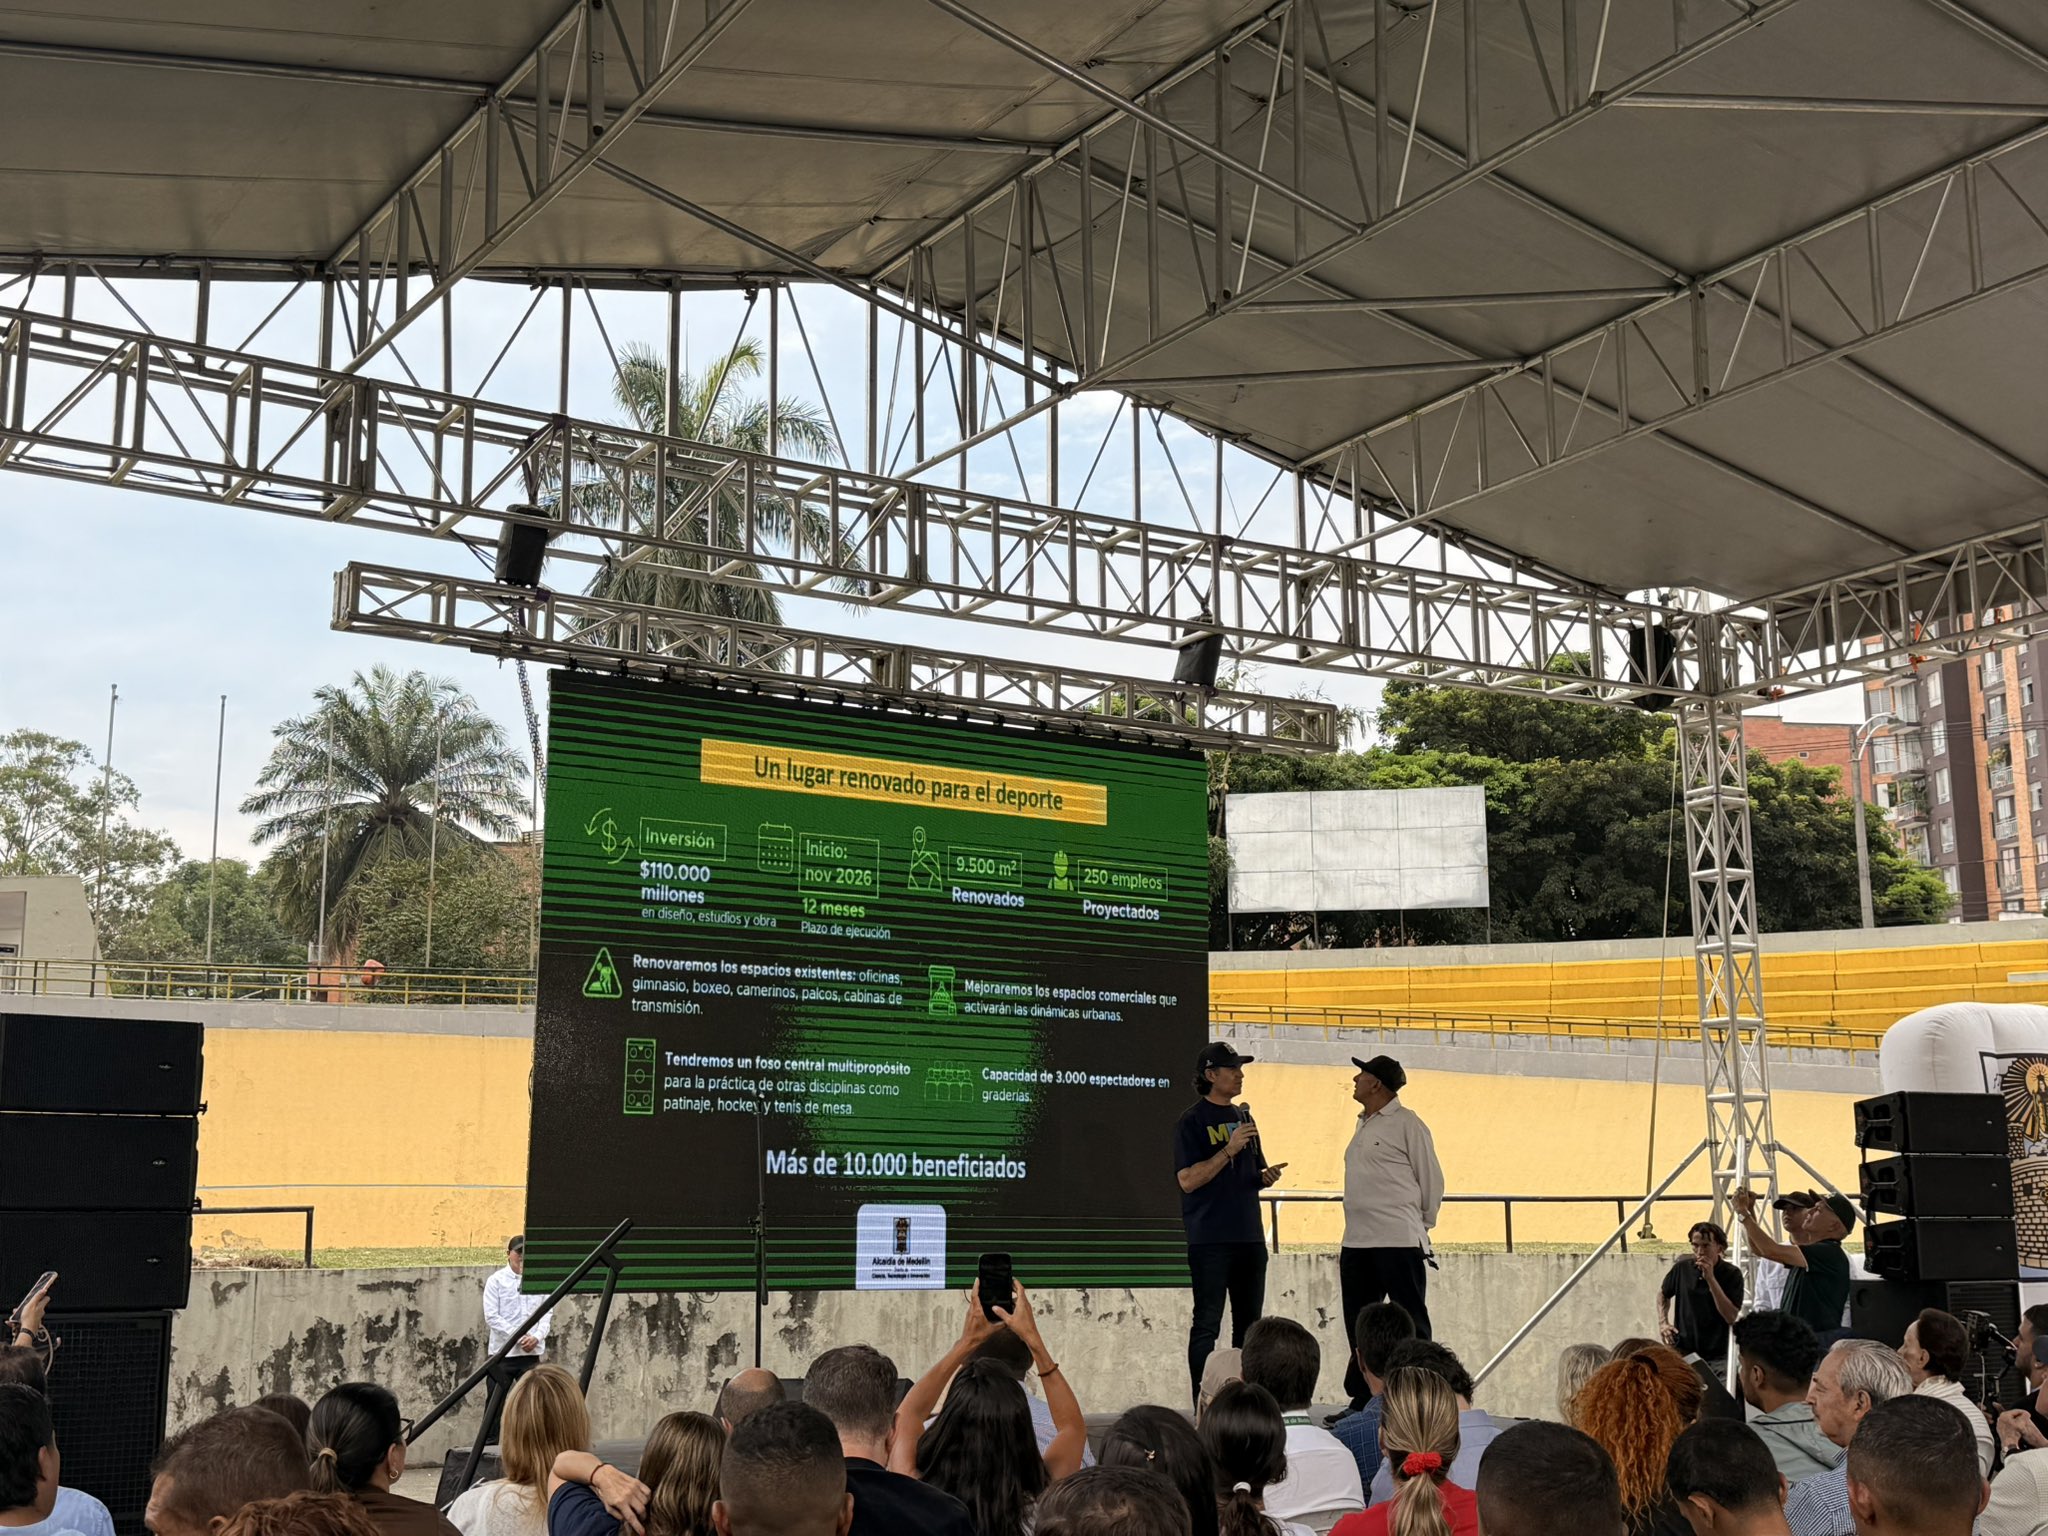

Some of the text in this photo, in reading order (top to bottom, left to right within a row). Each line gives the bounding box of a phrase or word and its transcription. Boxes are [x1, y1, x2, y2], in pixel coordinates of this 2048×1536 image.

[755, 754, 1063, 812] Un lugar renovado para el deporte
[646, 828, 714, 849] Inversión
[806, 840, 848, 859] Inicio:
[640, 860, 711, 882] $110.000
[957, 856, 995, 875] 9.500
[806, 868, 872, 886] nov 2026
[1084, 868, 1162, 890] 250 empleos
[641, 885, 704, 904] millones
[952, 886, 1024, 907] Renovados
[642, 906, 776, 928] en diseño, estudios y obra
[803, 898, 865, 918] 12 meses
[1083, 899, 1159, 921] Proyectados
[802, 921, 890, 941] Plazo de ejecución
[633, 954, 903, 986] Renovaremos los espacios existentes: oficinas,
[633, 978, 902, 1004] gimnasio, boxeo, camerinos, palcos, cabinas de
[965, 979, 1177, 1007] Mejoraremos los espacios comerciales que
[632, 999, 703, 1015] transmisión.
[965, 1002, 1123, 1022] activarán las dinámicas urbanas.
[665, 1052, 911, 1076] Tendremos un foso central multipropósito
[664, 1075, 899, 1096] para la práctica de otras disciplinas como
[982, 1067, 1169, 1088] Capacidad de 3.000 espectadores en
[982, 1088, 1031, 1102] graderías.
[664, 1097, 714, 1113] patinaje,
[764, 1101, 771, 1115] y
[775, 1100, 800, 1112] tenis
[804, 1101, 819, 1113] de
[823, 1103, 854, 1114] mesa.
[766, 1148, 1026, 1178] Más de 10.000 beneficiados
